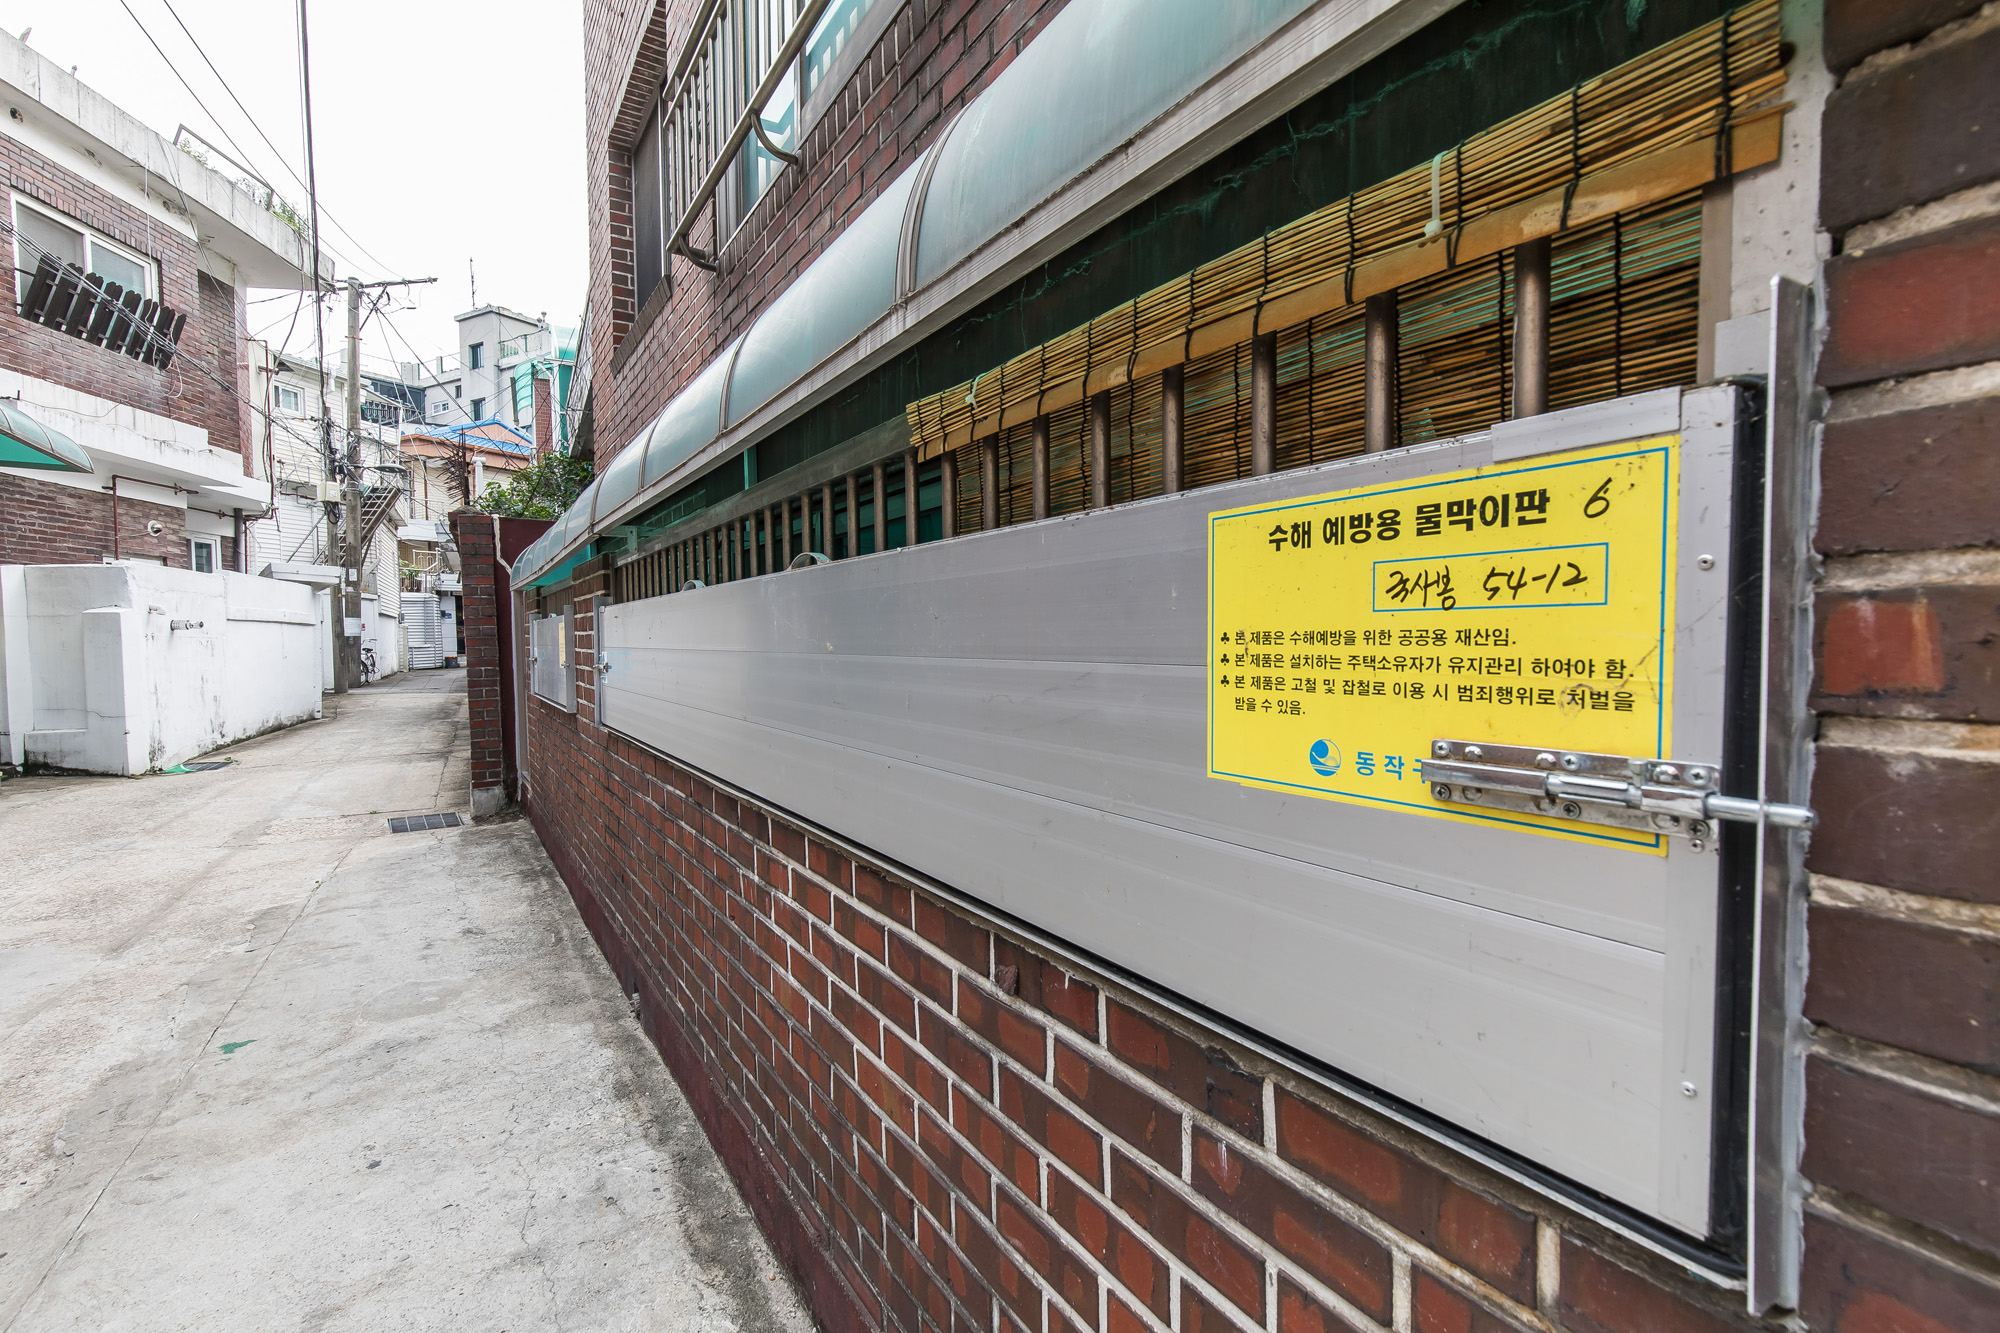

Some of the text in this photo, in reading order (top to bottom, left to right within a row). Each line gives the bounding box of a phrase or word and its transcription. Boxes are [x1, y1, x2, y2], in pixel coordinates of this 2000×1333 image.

[1583, 477, 1613, 519] 6
[1268, 488, 1551, 552] 수해 예방용 물막이판
[1482, 562, 1588, 600] 54-12
[1235, 628, 1517, 647] 본 제품은 수해예방을 위한 공공용 재산임.
[1234, 653, 1635, 679] 본 제품은 설치하는 주택소유자가 유지관리 하여야 함.
[1234, 675, 1636, 712] 본 제품은 고철 및 잡철로 이용 시 범죄행위로 처벌을
[1234, 696, 1306, 716] 받을 수 있음.
